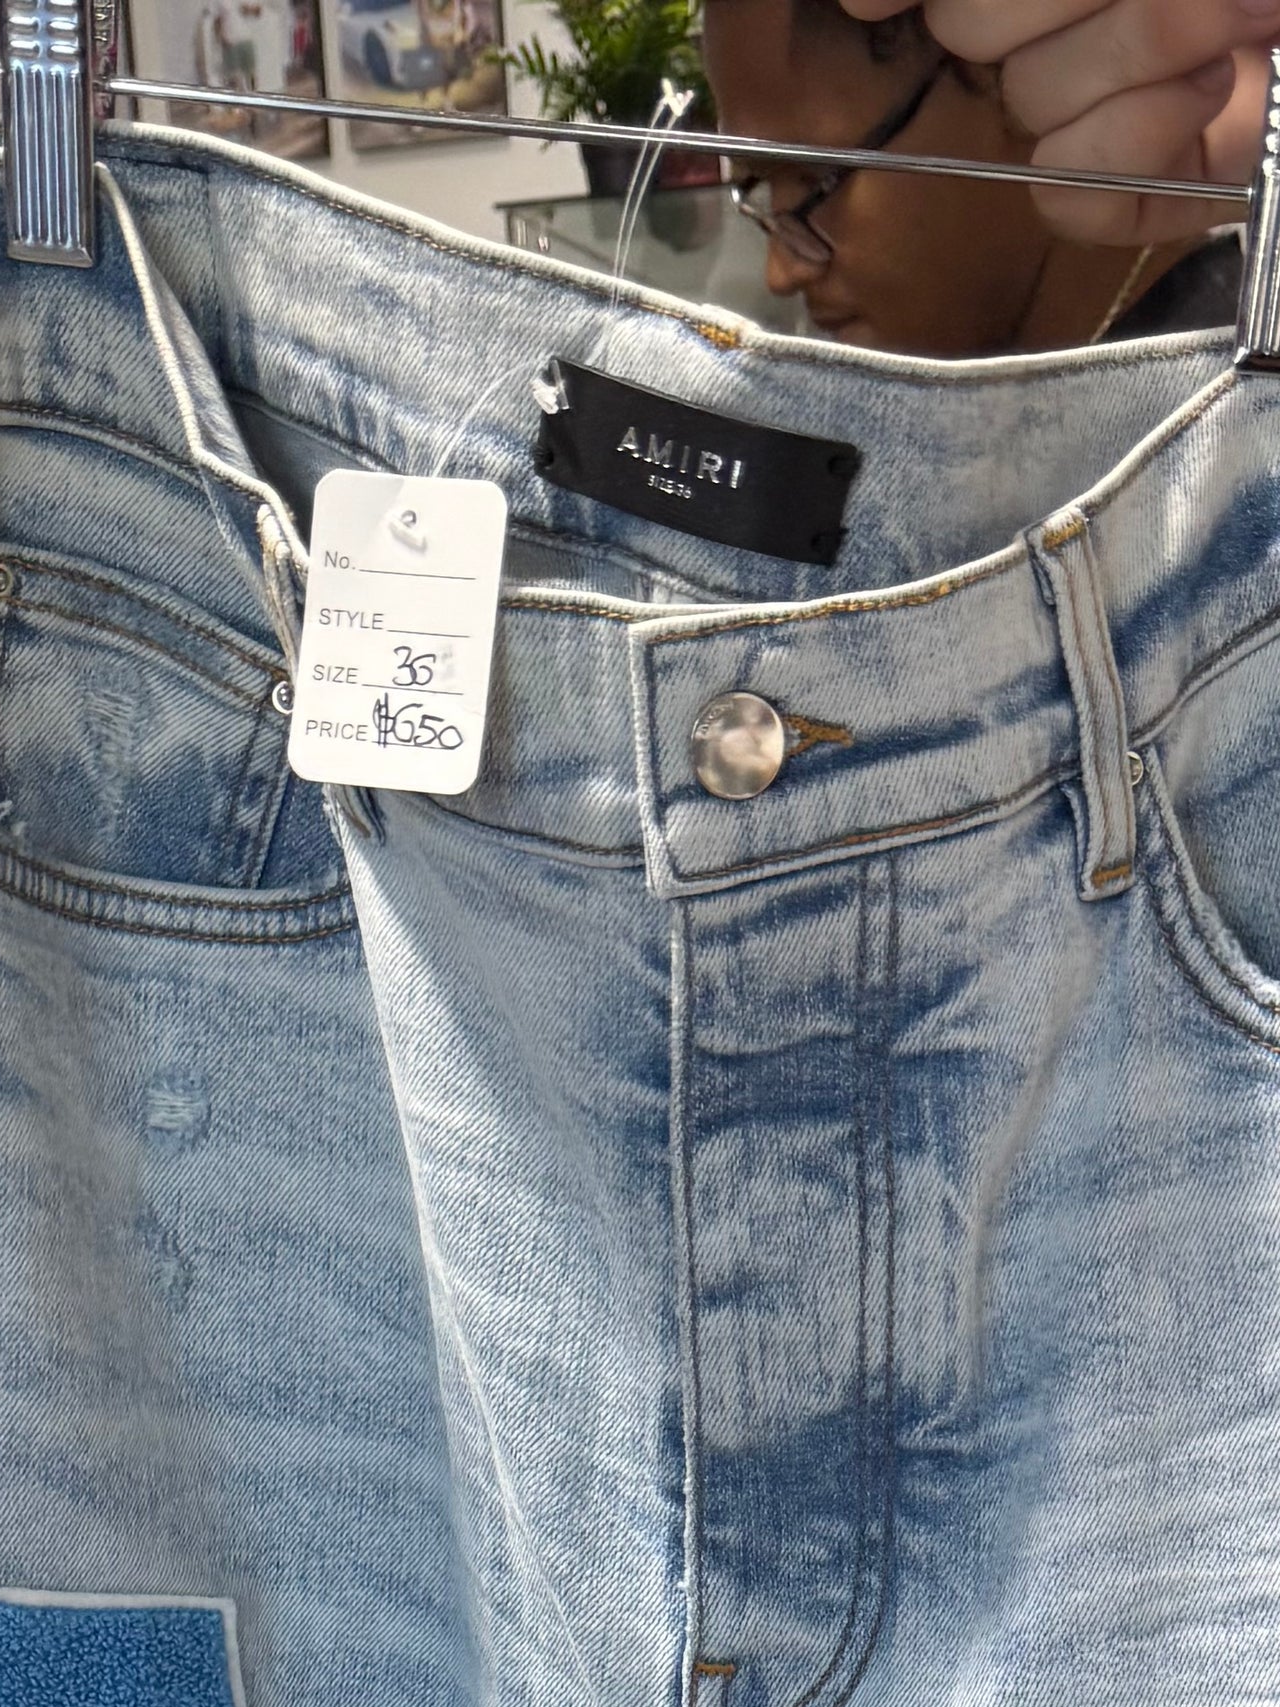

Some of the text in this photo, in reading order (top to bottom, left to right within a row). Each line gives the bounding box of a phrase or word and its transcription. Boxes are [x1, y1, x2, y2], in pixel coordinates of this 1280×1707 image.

[616, 426, 746, 489] AMIRI
[323, 550, 356, 571] No.
[318, 607, 385, 631] STYLE
[312, 645, 437, 687] SIZE 36
[304, 692, 464, 750] PRICE $650
